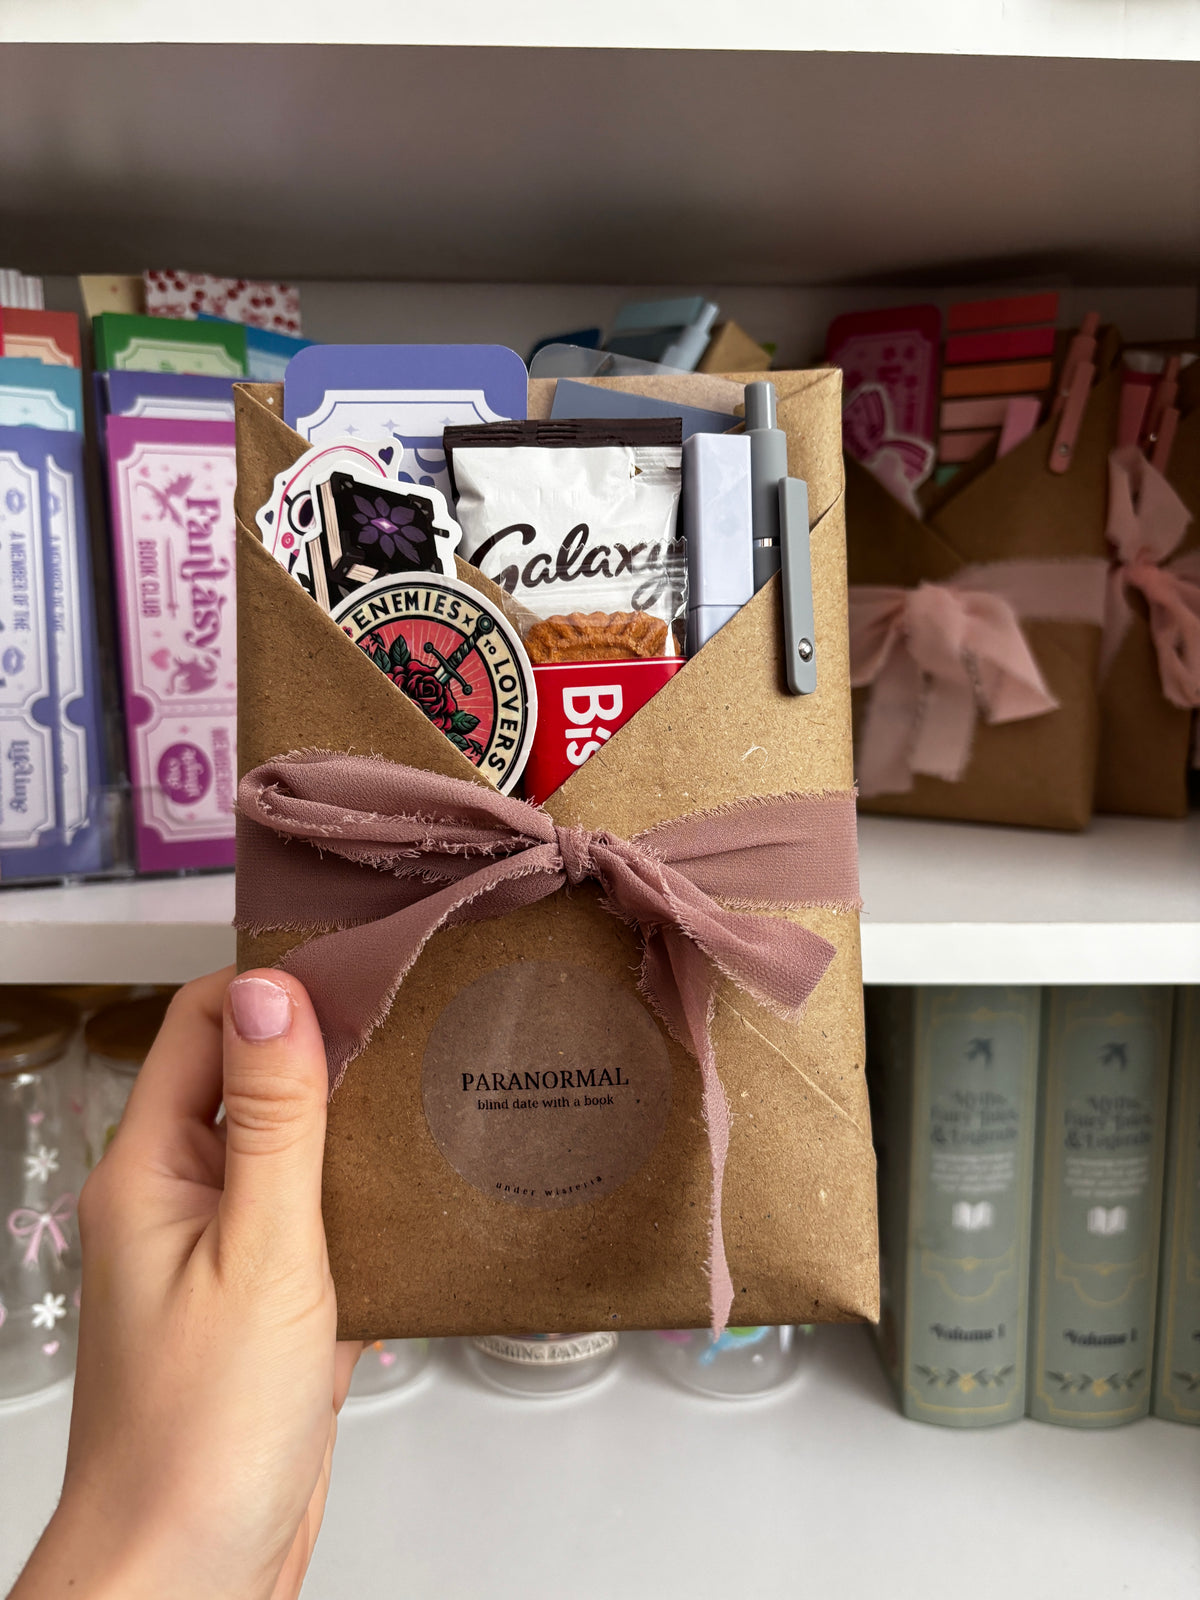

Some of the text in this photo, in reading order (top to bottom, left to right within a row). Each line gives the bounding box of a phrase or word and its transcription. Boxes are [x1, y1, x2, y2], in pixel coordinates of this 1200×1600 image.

[137, 539, 161, 619] BOOK CLUB
[180, 498, 230, 656] Fantasy
[468, 523, 688, 611] Galaxy
[352, 590, 520, 772] ENEMIES TO LOVERS
[462, 1067, 629, 1091] PARANORMAL
[477, 1094, 615, 1111] blind date with a book
[495, 1181, 536, 1197] under
